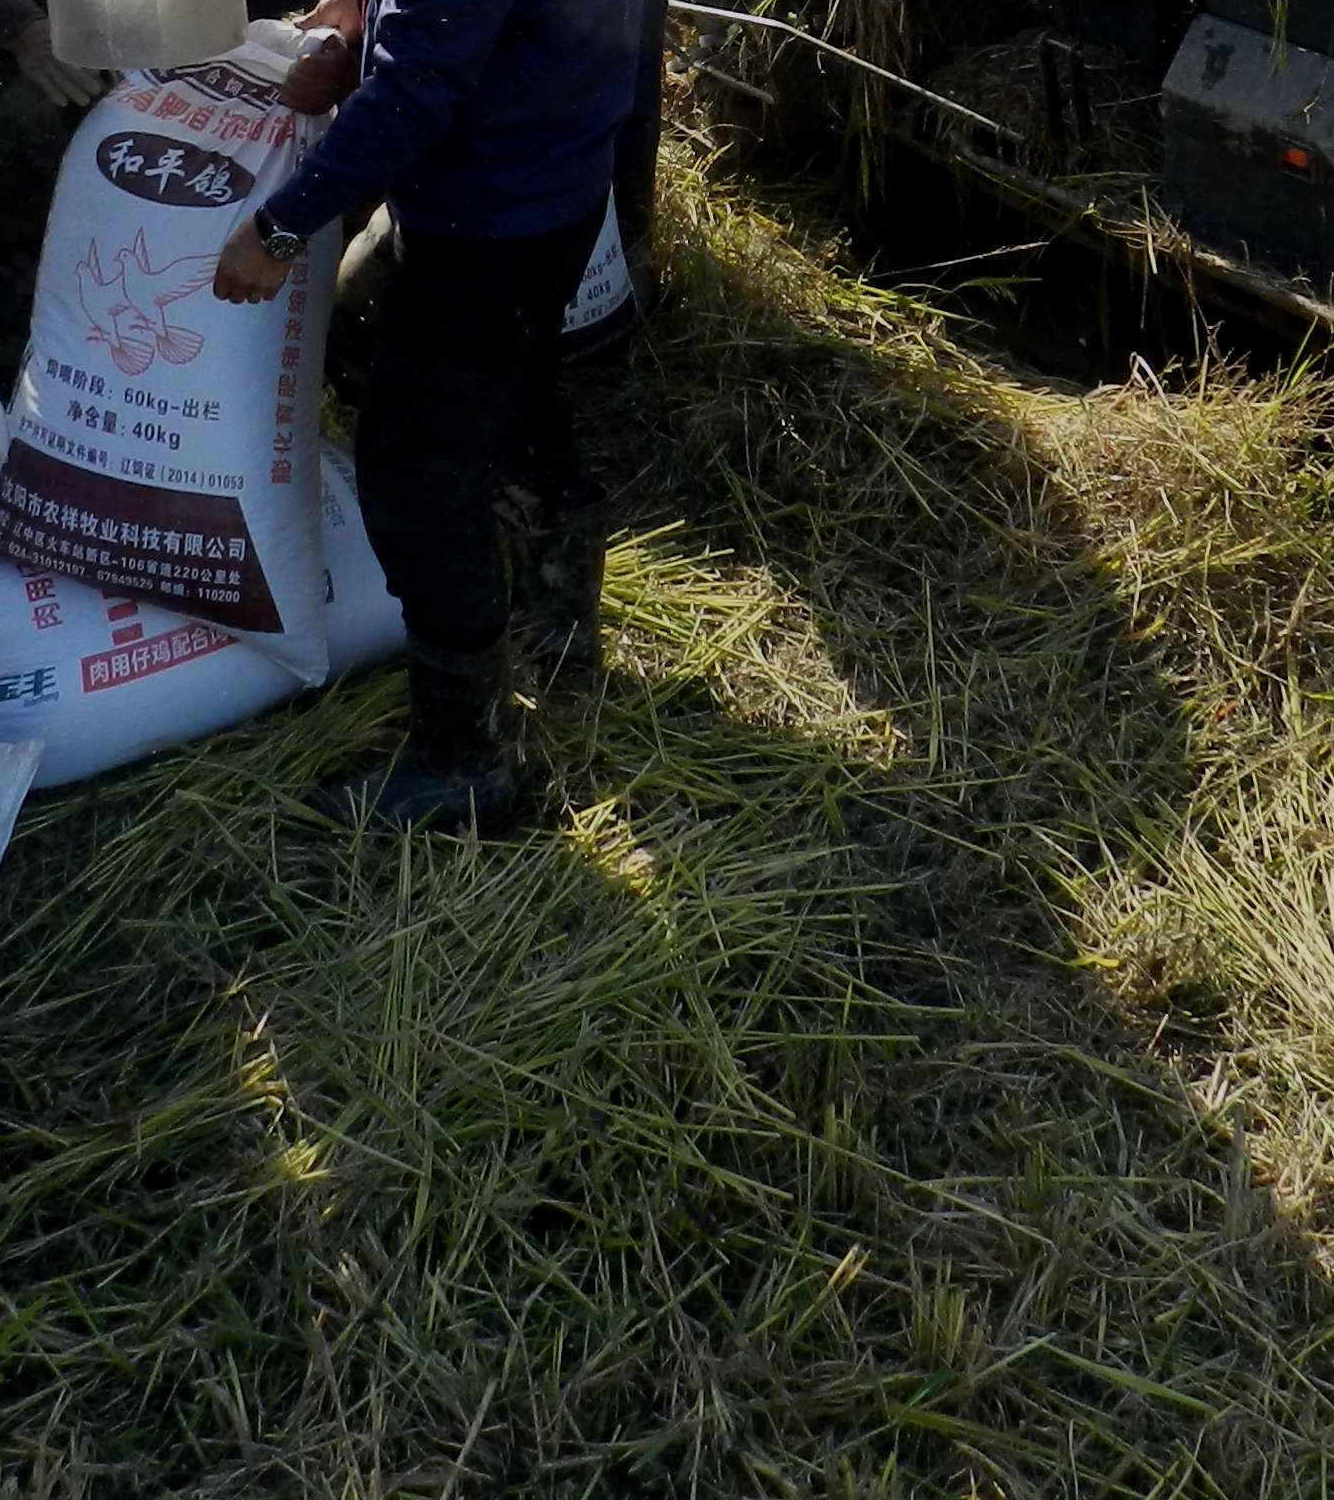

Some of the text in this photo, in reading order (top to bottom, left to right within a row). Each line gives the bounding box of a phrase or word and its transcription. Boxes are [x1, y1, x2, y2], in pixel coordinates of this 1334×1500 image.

[108, 138, 234, 203] 和平鸽
[271, 254, 311, 485] 膨化育肥猪浓缩饲
[0, 475, 248, 563] 沈阳市农祥牧业科技有限公司
